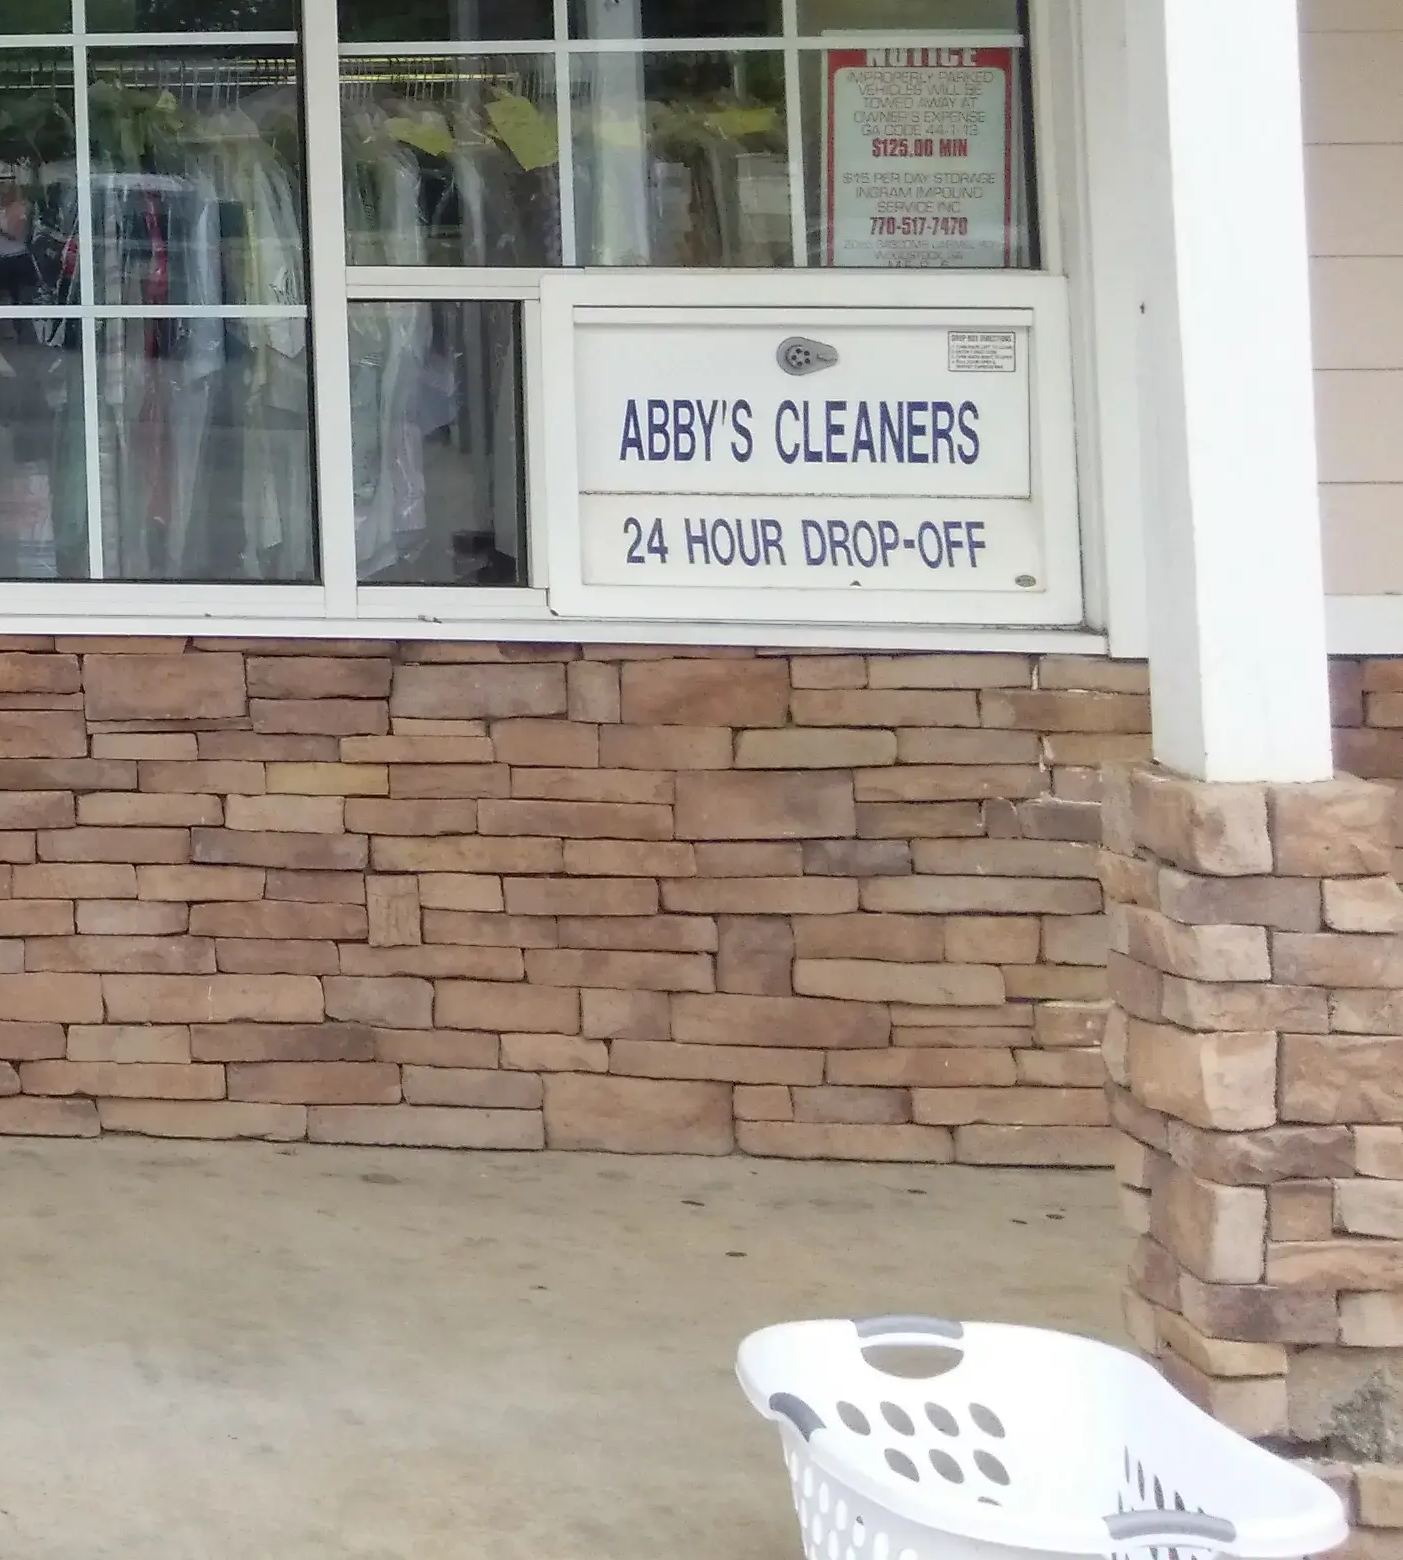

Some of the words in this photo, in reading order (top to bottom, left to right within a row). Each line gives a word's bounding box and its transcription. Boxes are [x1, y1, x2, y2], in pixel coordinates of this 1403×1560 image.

[866, 47, 977, 67] NOTICE
[847, 71, 933, 83] IMPROPERLY
[938, 71, 994, 83] PARKED
[859, 84, 922, 95] VEHICLES
[927, 84, 958, 95] WILL
[965, 84, 982, 95] BE
[863, 97, 913, 109] TOWED
[918, 97, 956, 108] AWAY
[961, 97, 978, 108] AT
[924, 110, 987, 123] EXPENSE
[861, 124, 880, 136] GA
[884, 124, 921, 136] CODE
[871, 138, 933, 157] $125.00
[939, 138, 968, 157] MIN
[874, 172, 901, 184] PER
[904, 172, 929, 184] DAY
[933, 172, 996, 184] STORAGE
[855, 187, 913, 199] INGRAM
[916, 187, 984, 199] IMPOUND
[877, 201, 934, 213] SERVICE
[869, 216, 968, 236] 770-517-7470
[619, 399, 753, 463] ABBY'S
[775, 399, 980, 465] CLEANERS
[623, 517, 668, 564] 24
[685, 517, 787, 566] HOUR
[802, 519, 987, 569] DROP-OFF
